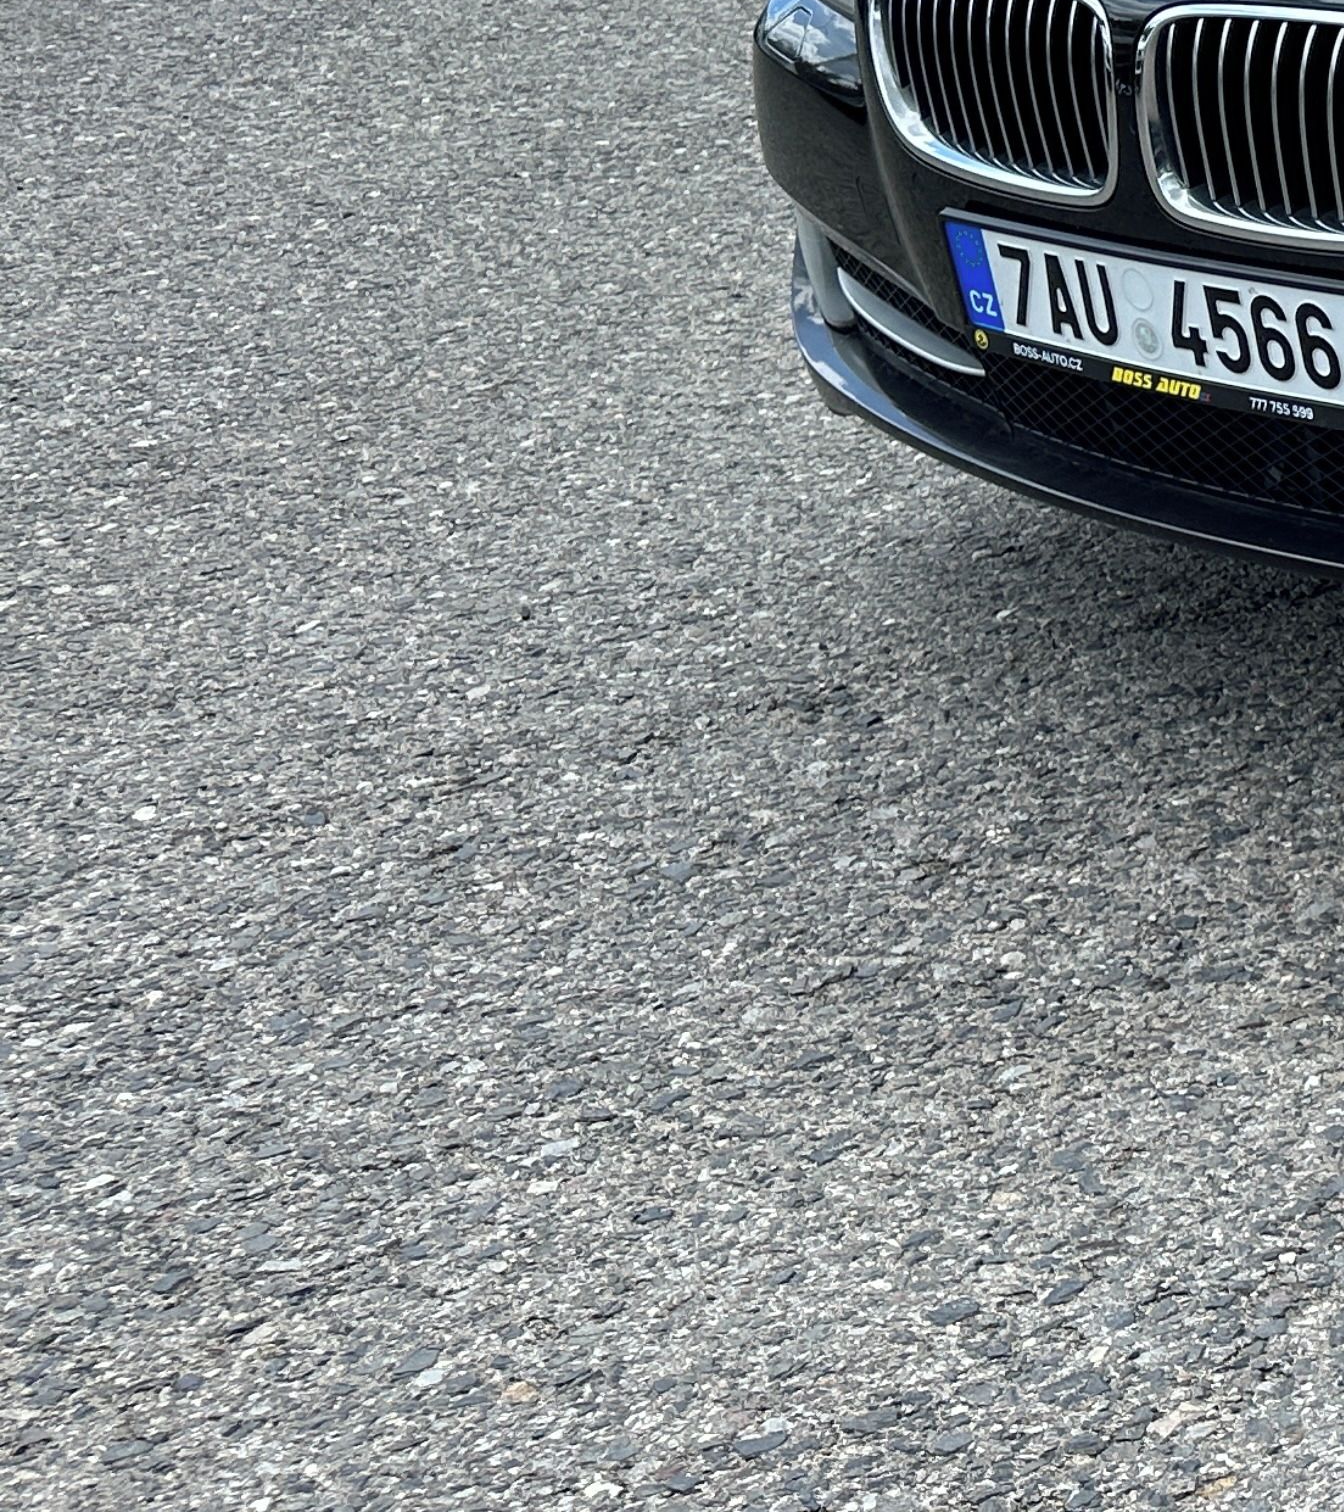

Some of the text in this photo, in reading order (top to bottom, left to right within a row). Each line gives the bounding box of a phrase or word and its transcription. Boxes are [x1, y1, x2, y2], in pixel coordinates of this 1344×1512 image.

[969, 243, 1343, 390] CZ 7AU 4566
[1012, 341, 1084, 372] BOSS-AUTO.CZ
[1111, 365, 1153, 390] BOSS
[1155, 376, 1202, 400] AUTO
